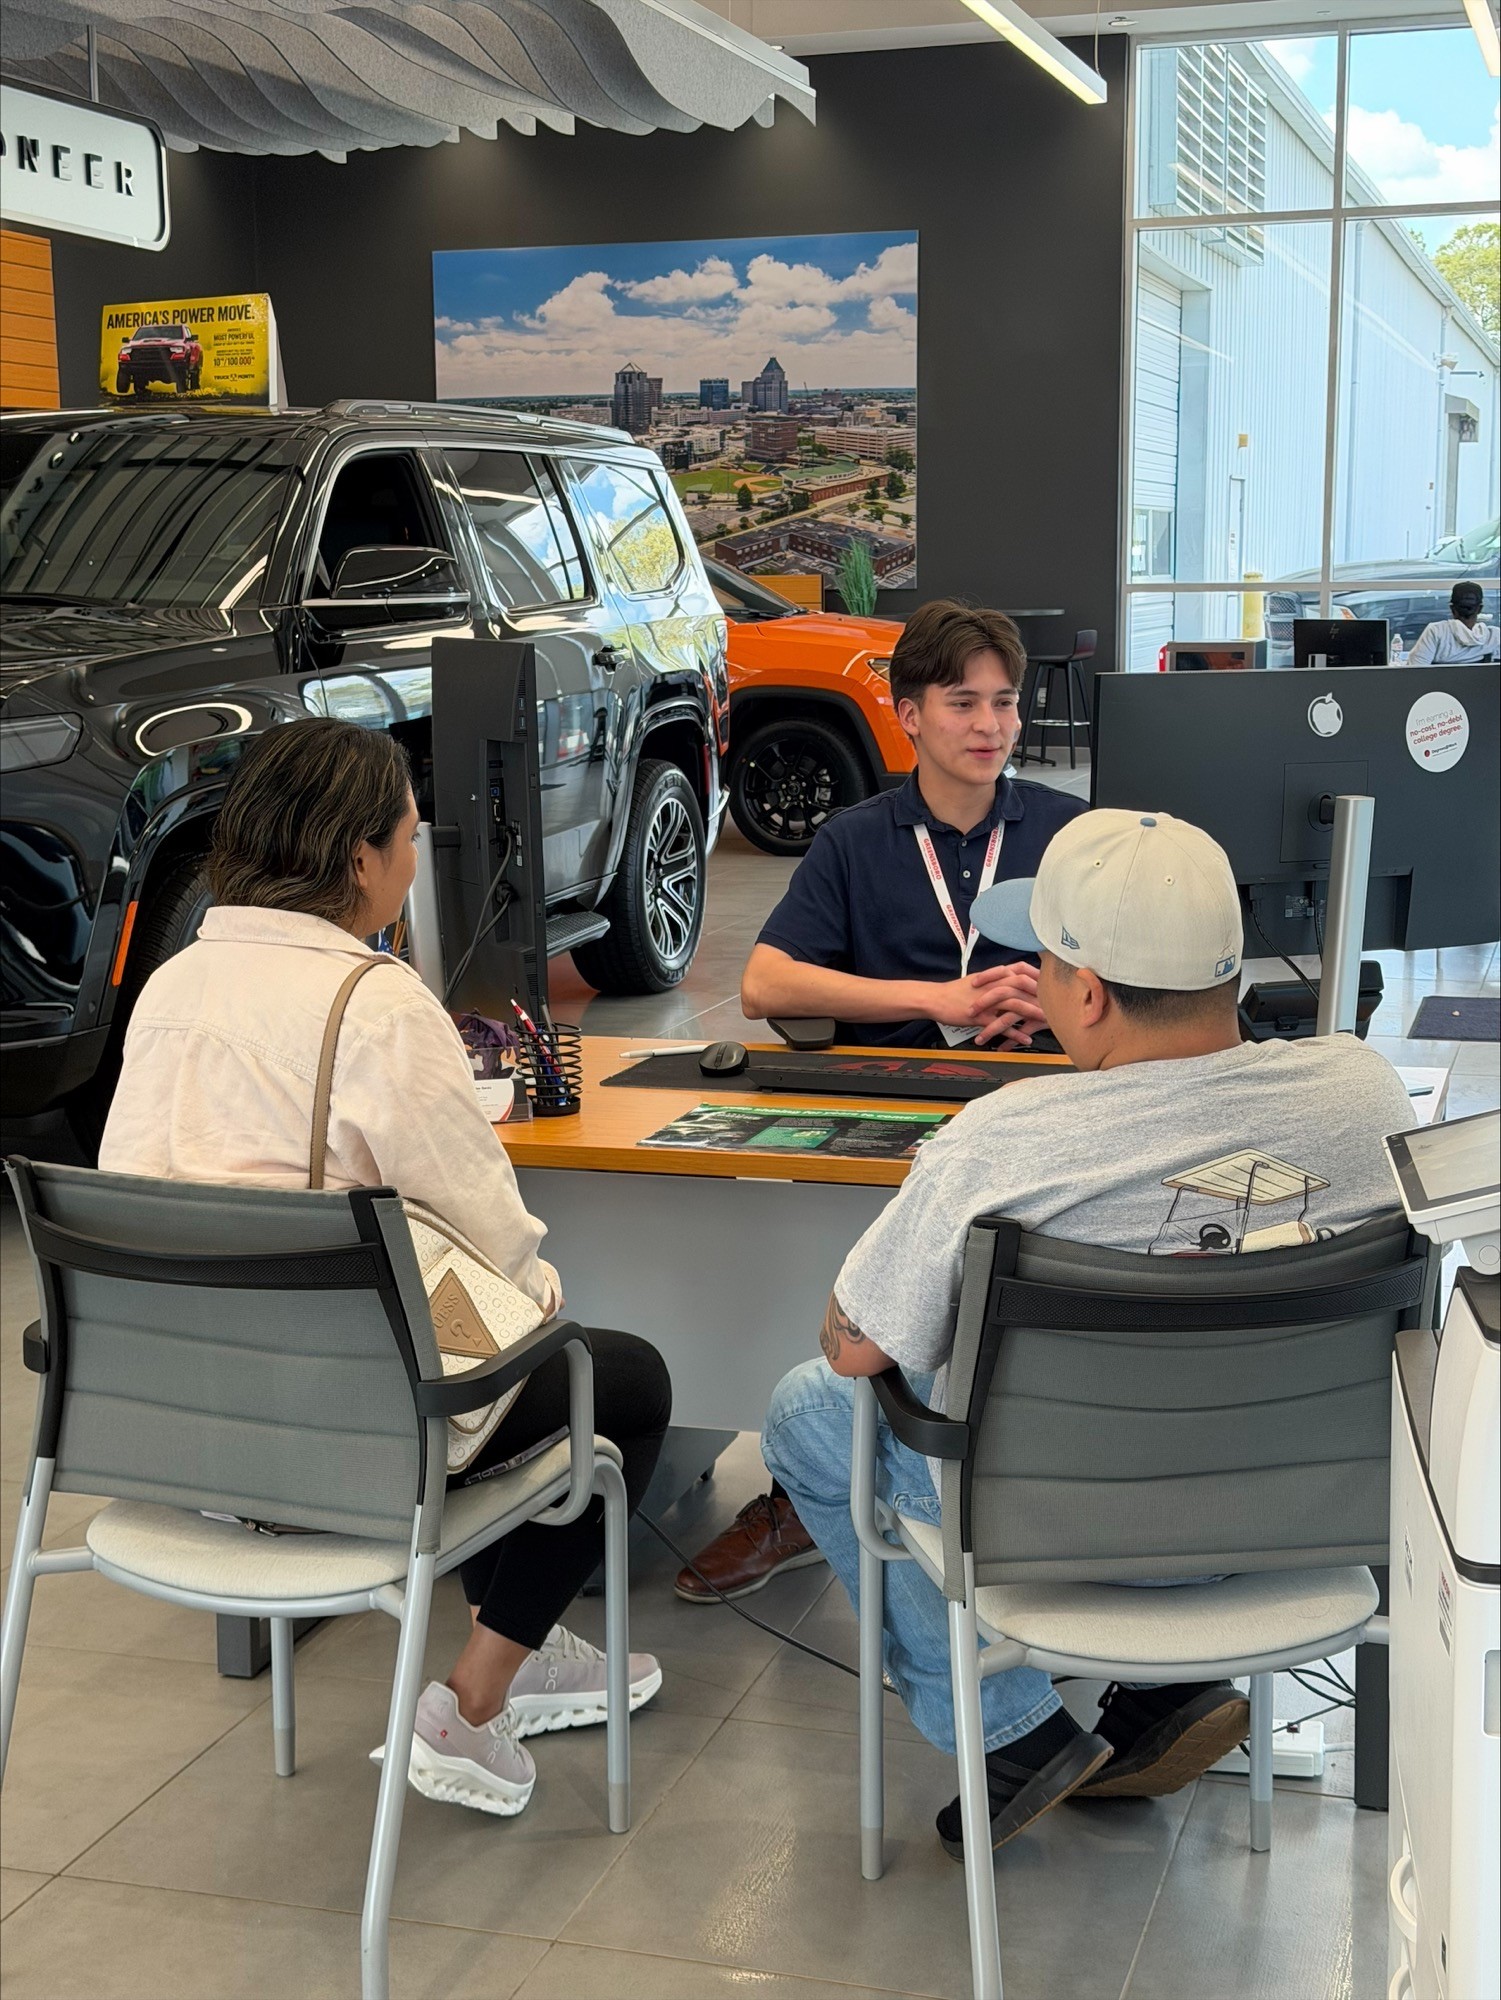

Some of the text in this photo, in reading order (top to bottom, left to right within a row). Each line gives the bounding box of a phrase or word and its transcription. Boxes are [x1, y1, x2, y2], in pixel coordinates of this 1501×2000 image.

[0, 130, 136, 197] NEER
[107, 304, 255, 329] AMERICA'S POWER MOVE.
[1409, 715, 1463, 737] no-cost, no-debt
[1413, 725, 1463, 745] college degree.
[923, 838, 942, 880] GREENSBORO
